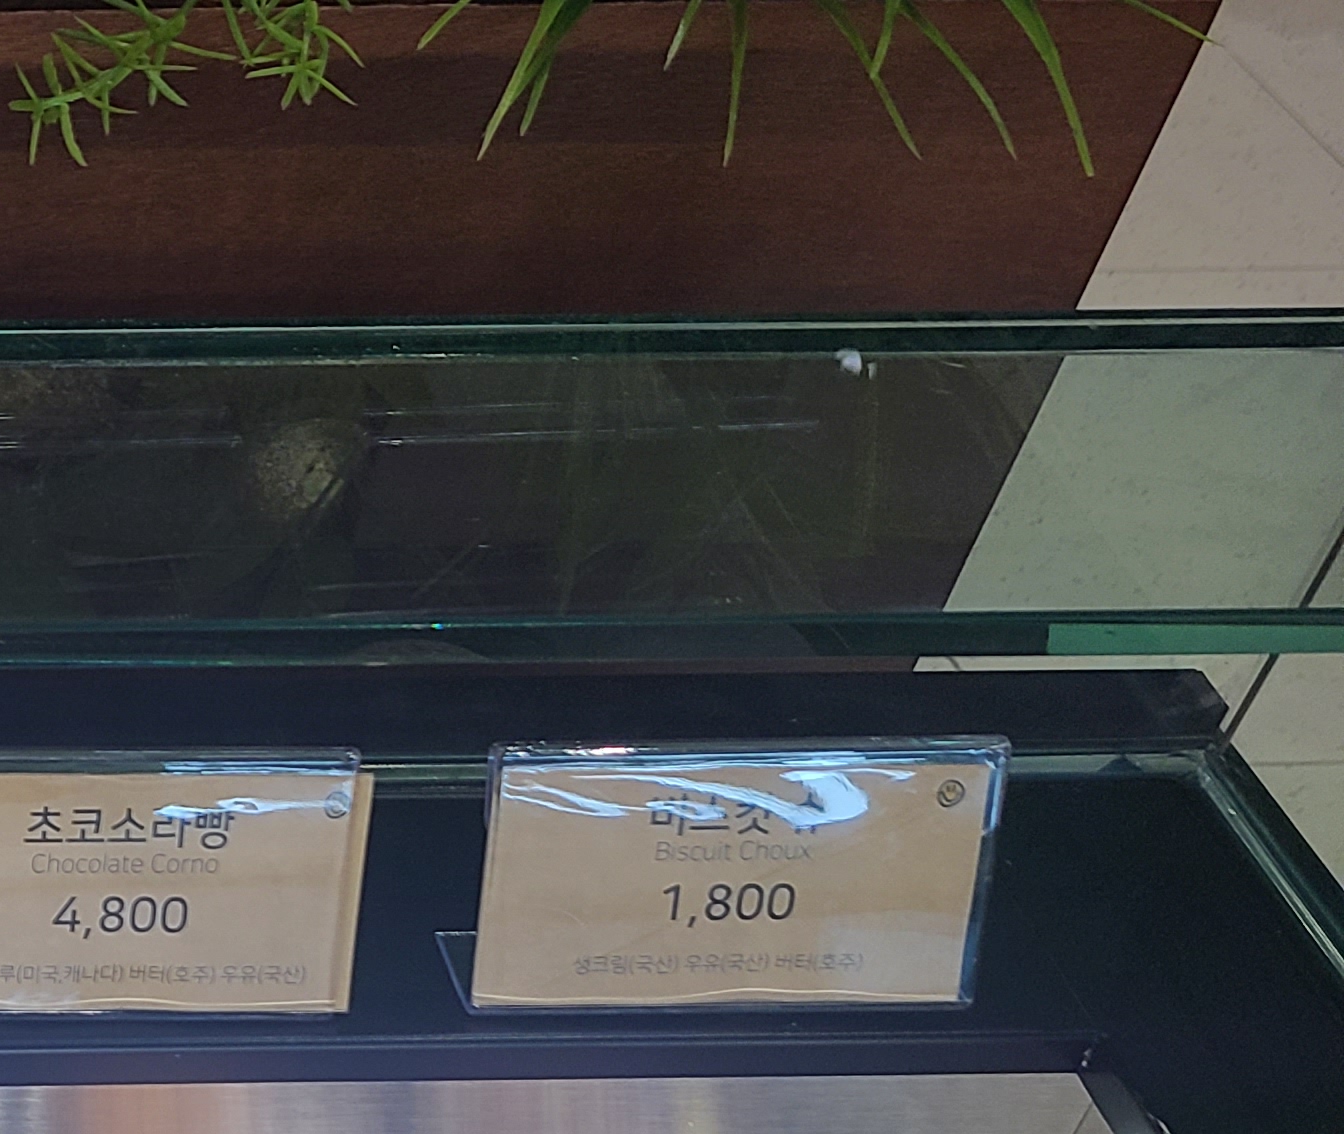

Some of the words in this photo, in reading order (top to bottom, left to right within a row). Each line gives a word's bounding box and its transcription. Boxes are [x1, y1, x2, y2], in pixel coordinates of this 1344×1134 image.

[23, 806, 235, 850] 초코소라빵
[654, 841, 730, 862] Biscuit
[740, 839, 812, 861] Choux
[31, 853, 144, 874] Chocolate
[151, 853, 219, 874] Corno
[662, 882, 796, 928] 1,800
[52, 895, 189, 940] 4,800
[683, 952, 770, 972] 우유(국산)
[129, 964, 216, 984] 버터(호주)
[220, 964, 306, 985] 우유(국산)
